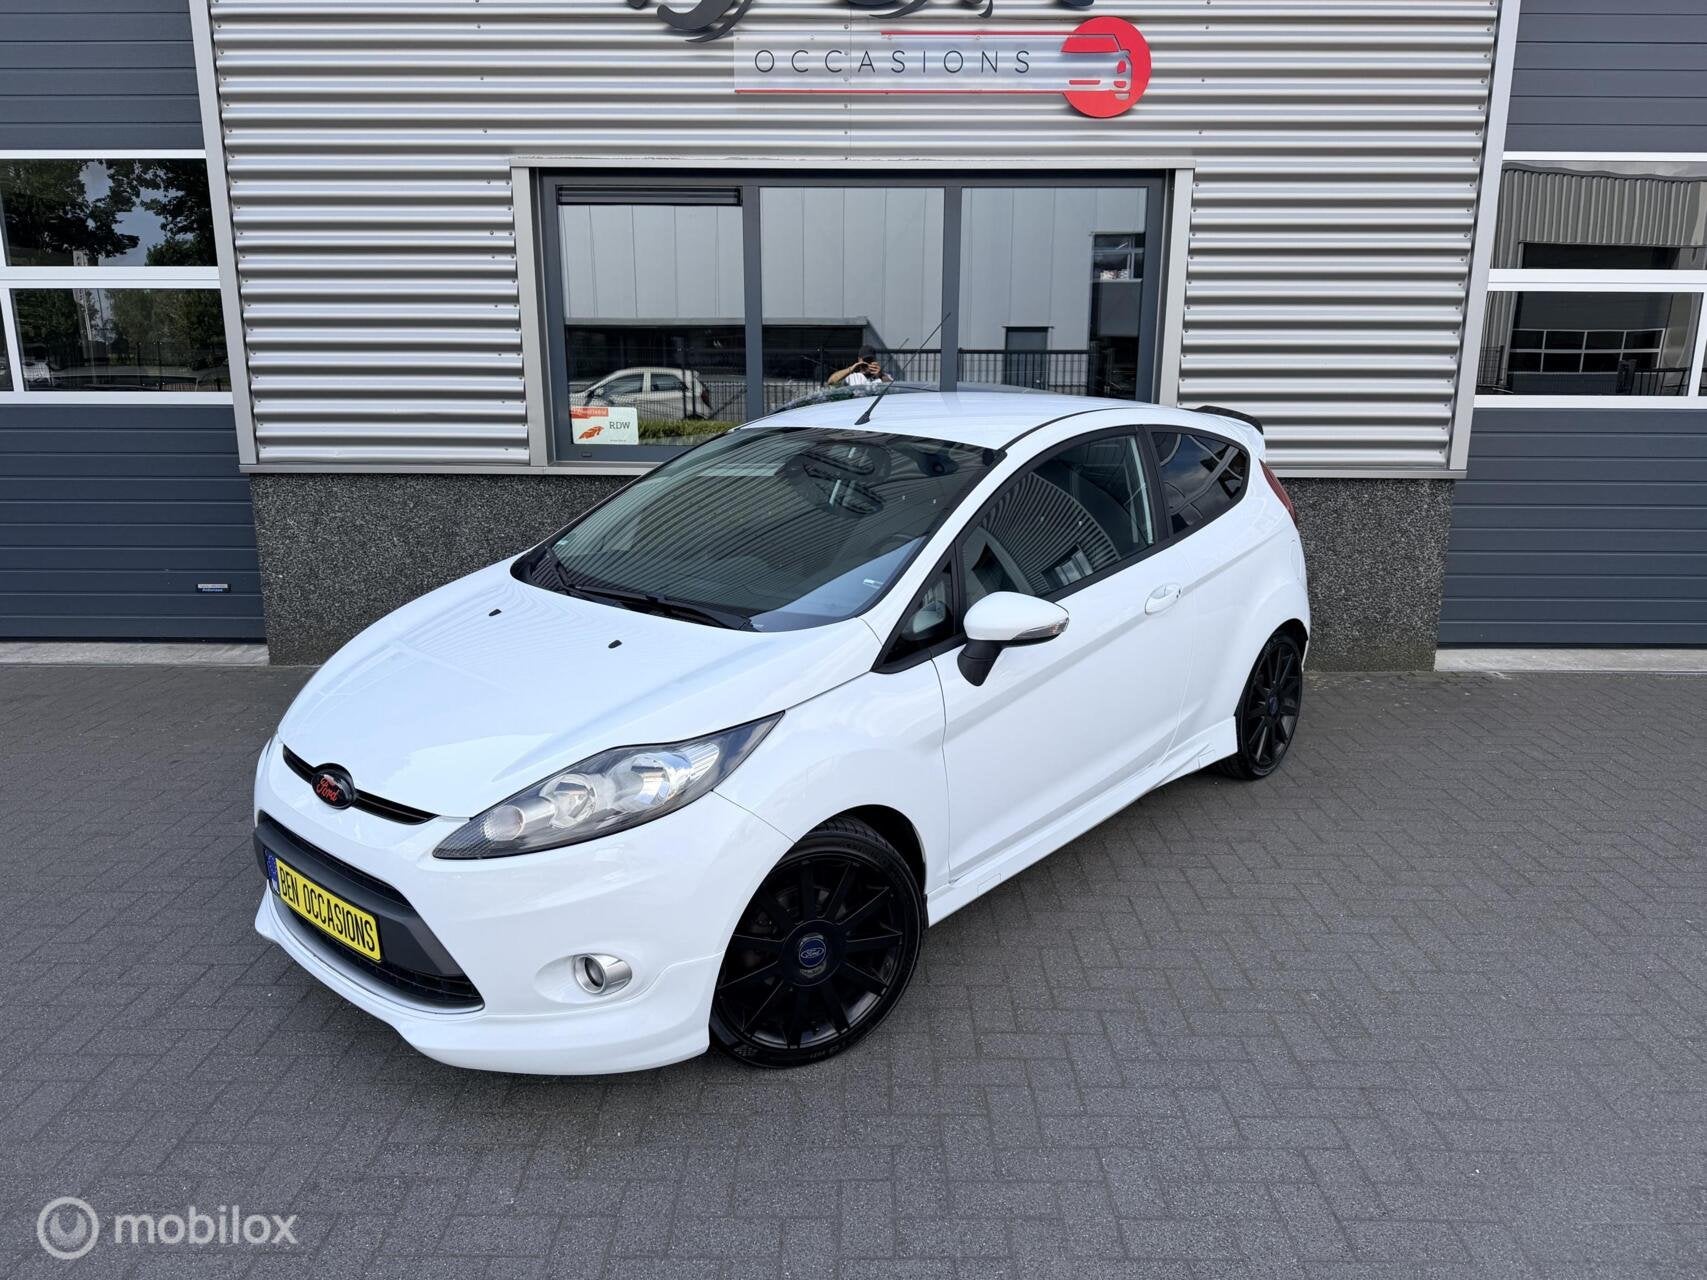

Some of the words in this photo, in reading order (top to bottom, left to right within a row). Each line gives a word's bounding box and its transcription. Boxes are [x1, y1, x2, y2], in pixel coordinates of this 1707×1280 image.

[754, 49, 1031, 74] OCCASIONS
[609, 421, 631, 430] RDW
[316, 777, 340, 802] Ford
[279, 866, 300, 907] BEN
[303, 884, 376, 952] OCCASIONS
